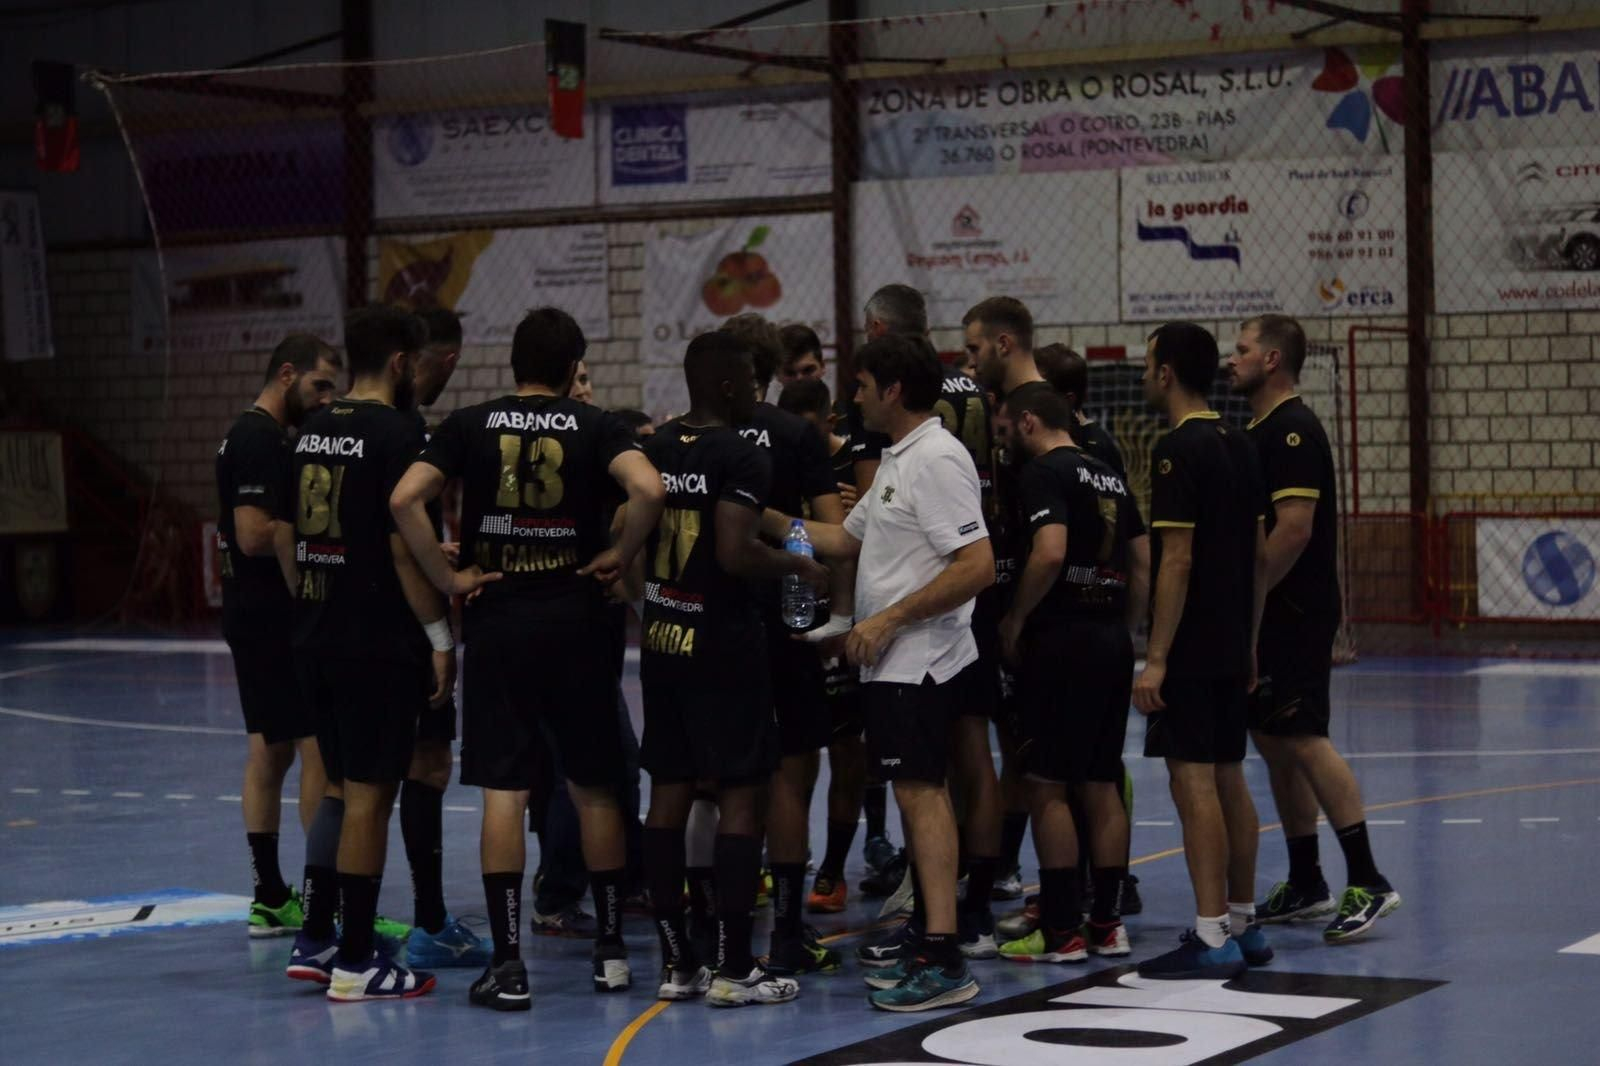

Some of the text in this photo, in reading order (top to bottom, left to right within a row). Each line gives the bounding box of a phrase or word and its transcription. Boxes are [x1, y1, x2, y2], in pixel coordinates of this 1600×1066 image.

[868, 64, 1292, 114] ZONA DE OBRA O ROSAL, S.L.U.
[442, 111, 554, 140] SAEXC
[1060, 118, 1076, 134] O
[1001, 145, 1016, 161] O
[1022, 142, 1074, 159] ROSAL
[1081, 134, 1209, 159] (PONTEVEDRA)
[1148, 194, 1249, 221] la guardia
[496, 433, 565, 511] 13
[513, 527, 576, 537] PONTEVEDRA
[507, 888, 519, 945] Kempa
[604, 884, 616, 936] Kempa
